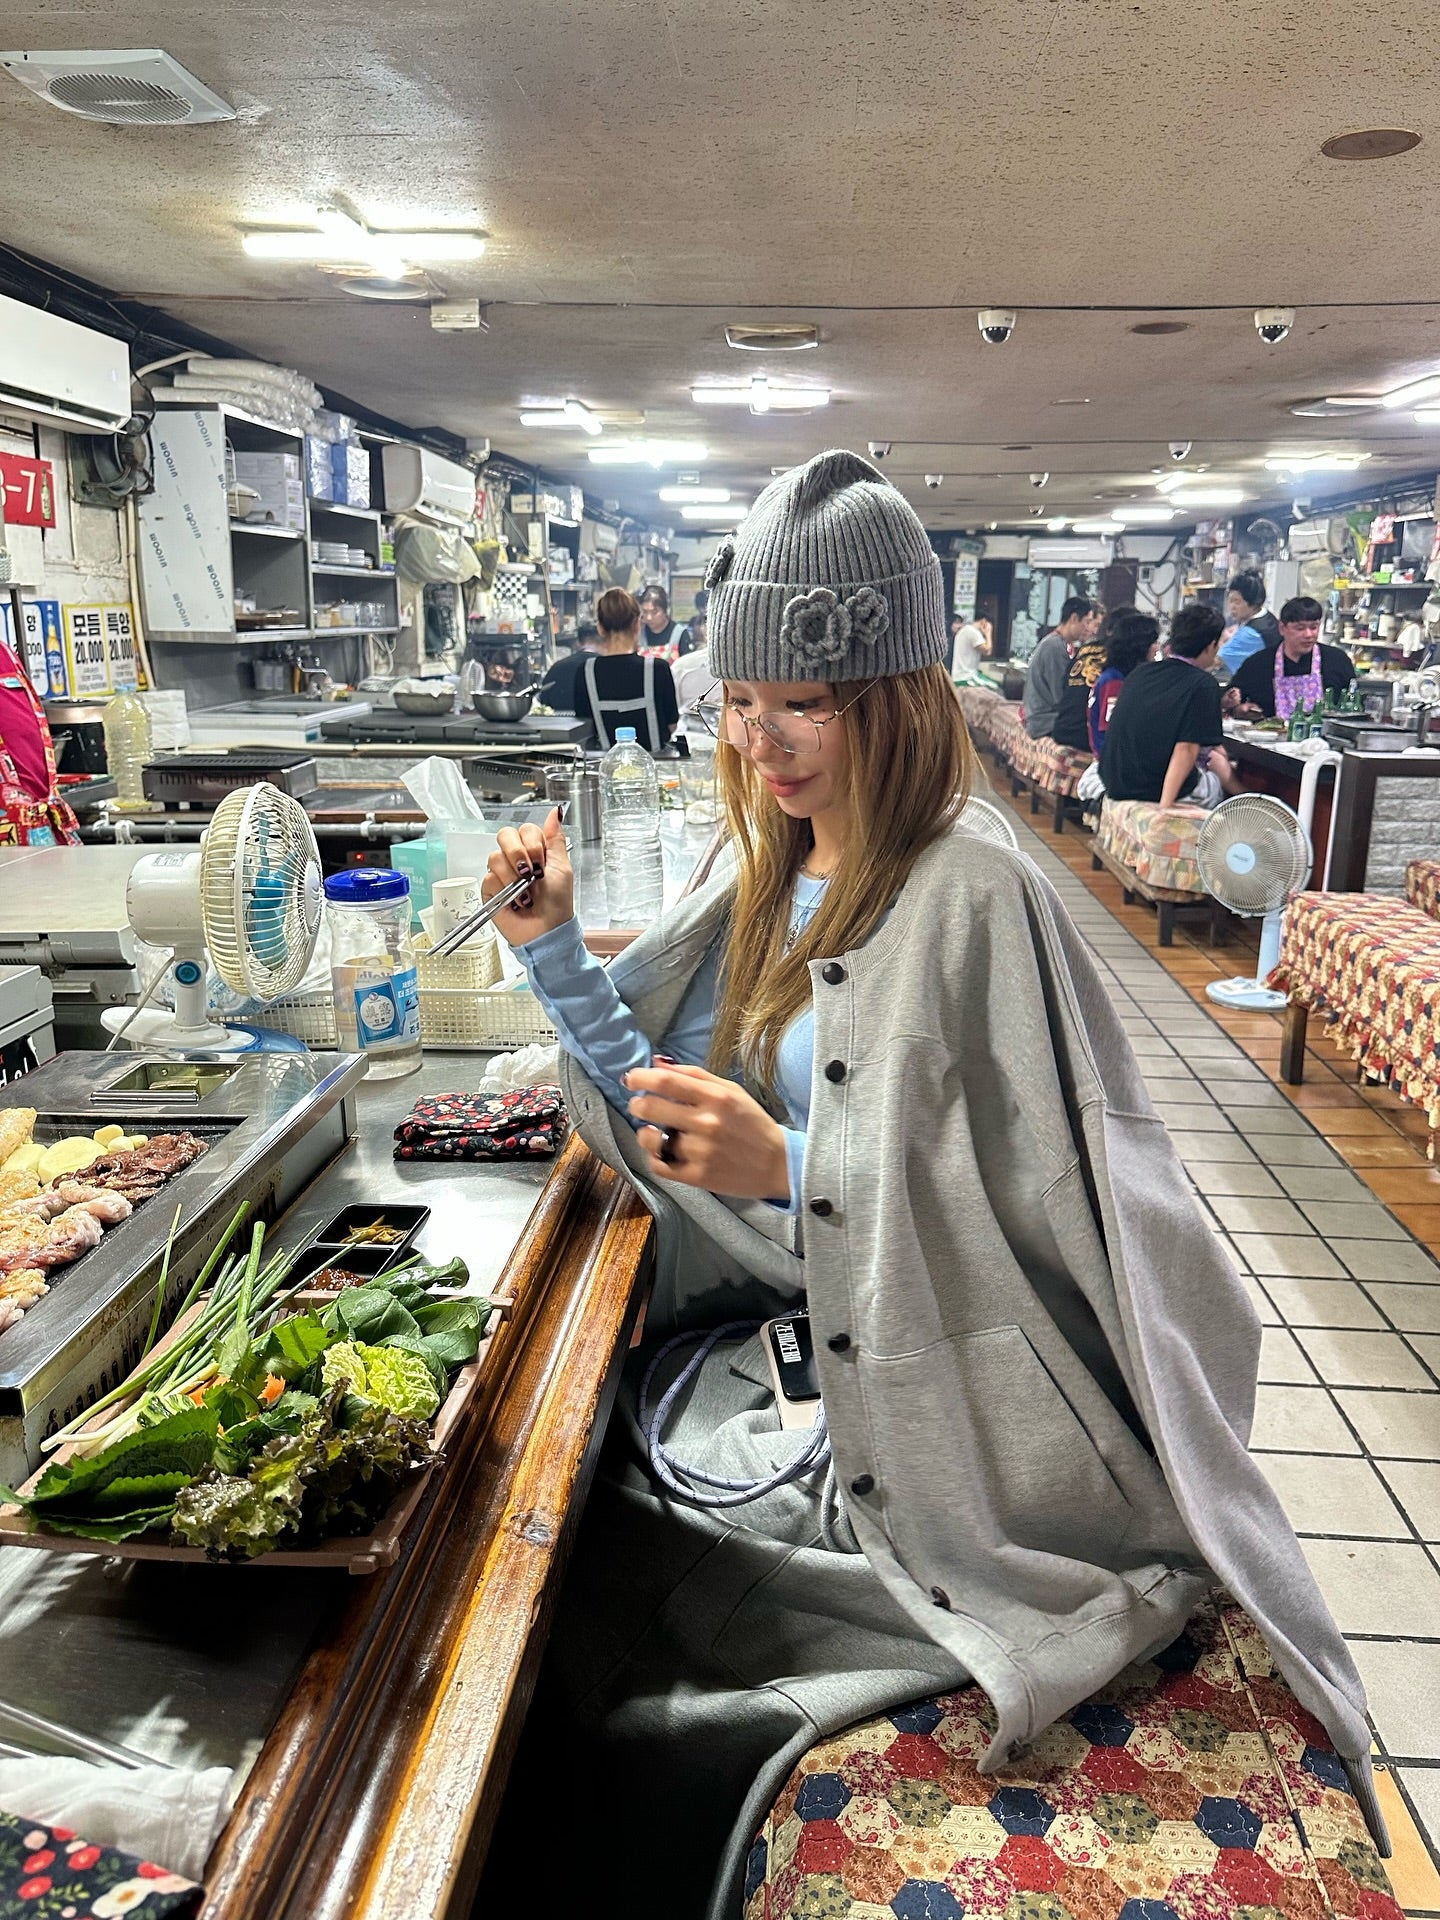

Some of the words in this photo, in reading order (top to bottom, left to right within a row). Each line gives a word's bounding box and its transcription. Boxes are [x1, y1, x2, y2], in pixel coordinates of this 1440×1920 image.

[73, 613, 101, 637] 모듬
[106, 612, 130, 636] 특양
[75, 640, 104, 664] 20,000
[775, 1322, 802, 1364] ZEROZERO
